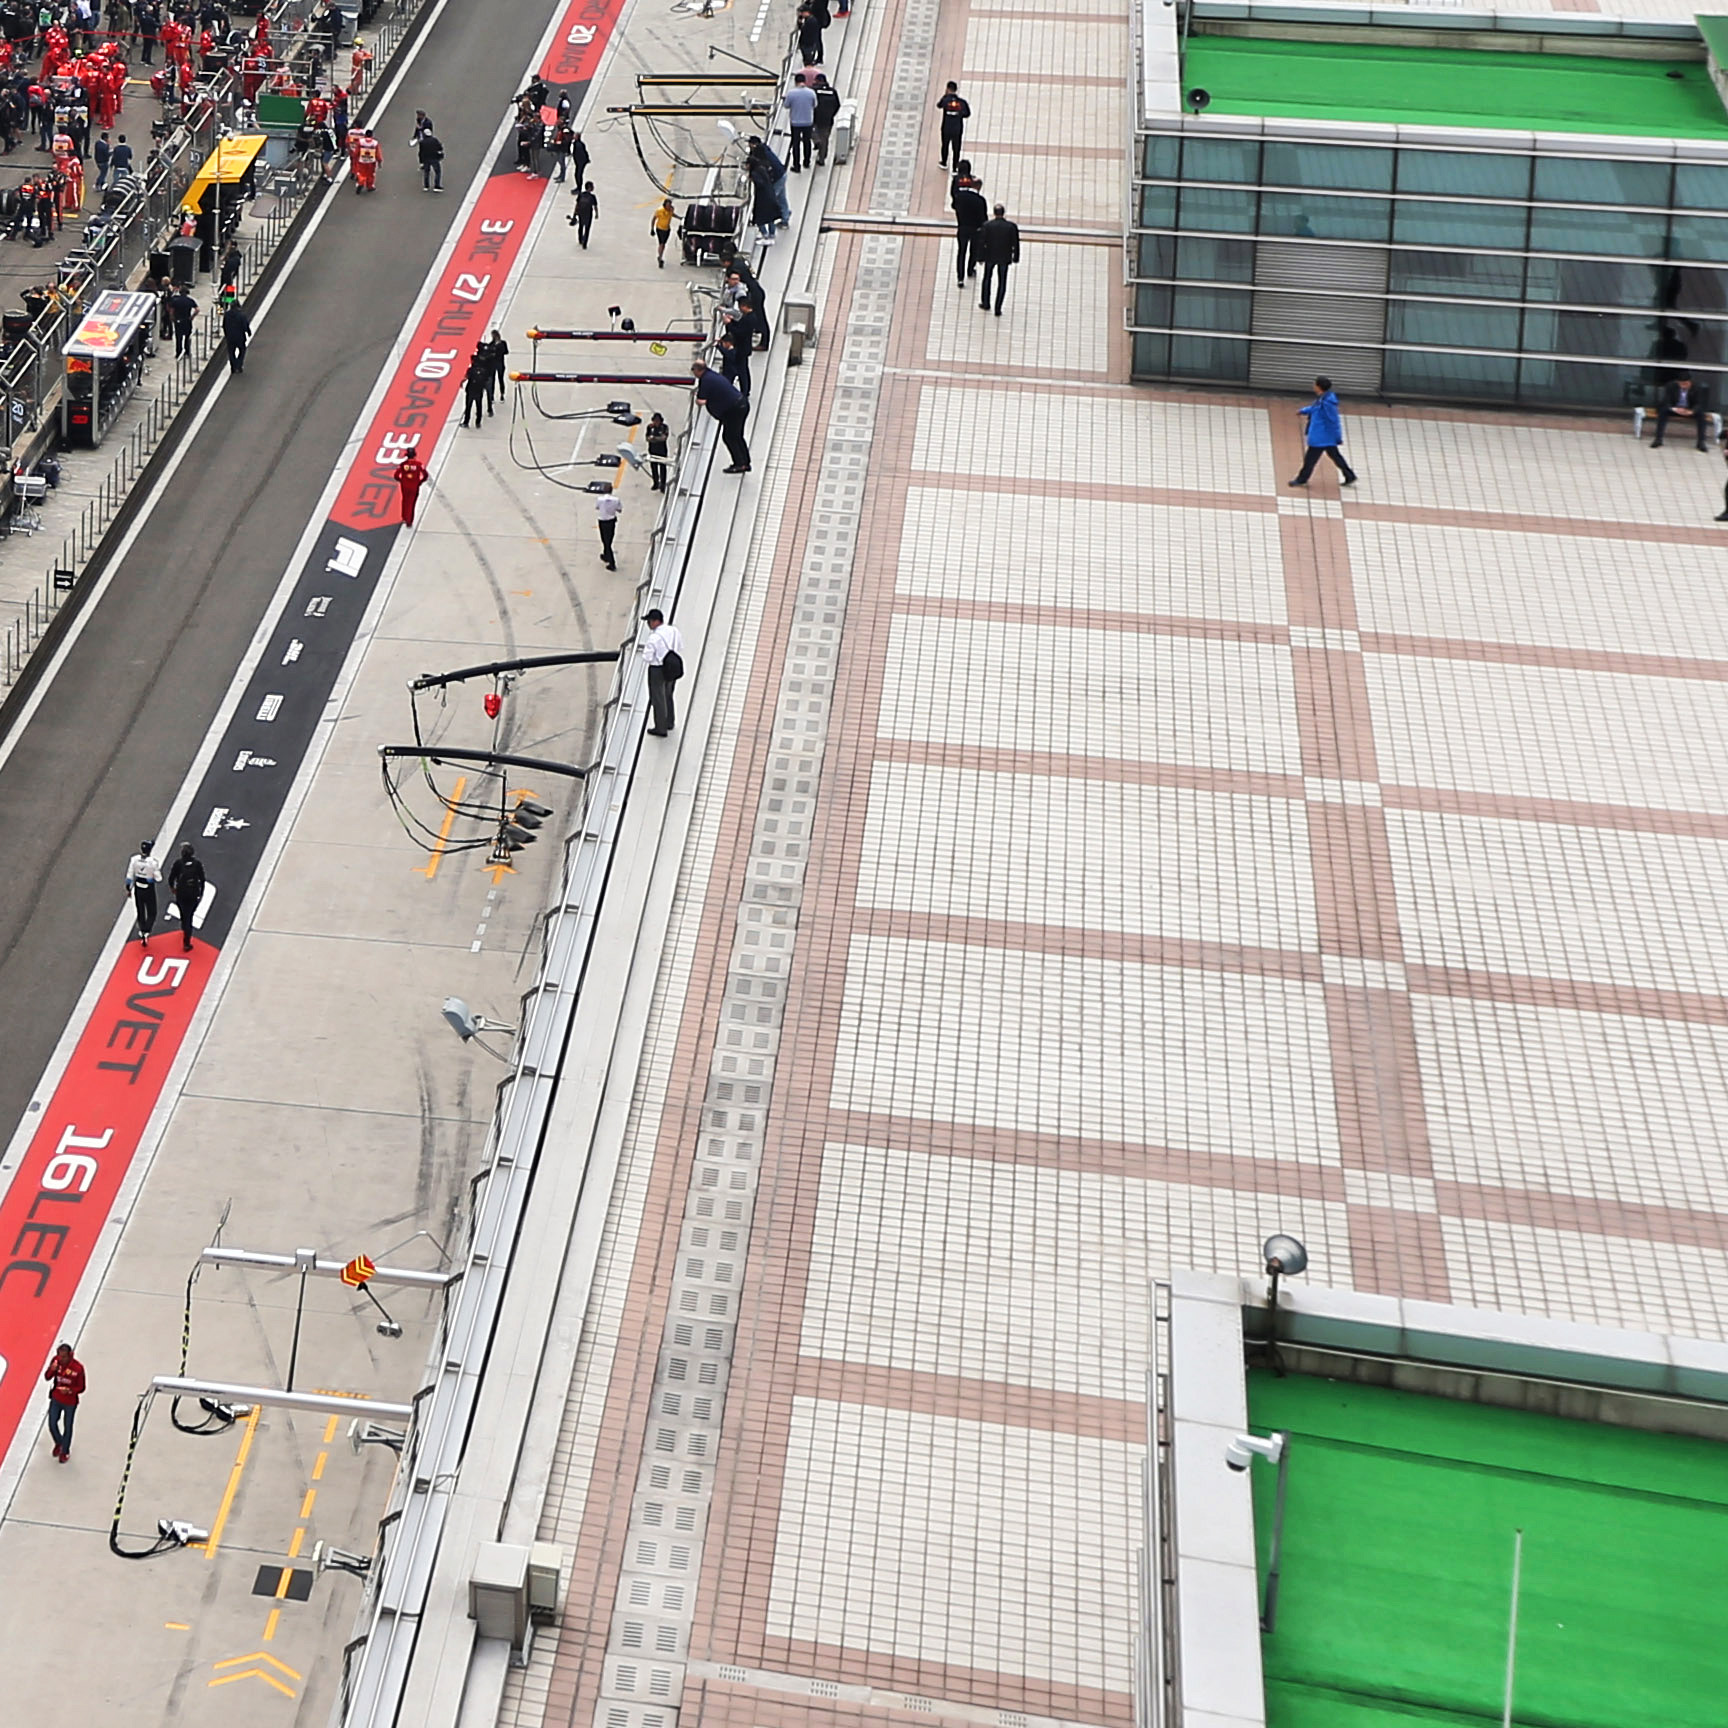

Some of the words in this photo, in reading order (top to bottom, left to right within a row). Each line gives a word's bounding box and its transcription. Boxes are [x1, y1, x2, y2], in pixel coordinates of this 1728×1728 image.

[567, 25, 597, 44] 20
[480, 219, 514, 234] 3
[451, 273, 491, 302] 27
[431, 298, 473, 343] HUL
[415, 347, 458, 379] 10
[392, 376, 443, 429] GAS
[376, 431, 421, 465] 33
[136, 955, 189, 989] 5
[97, 984, 167, 1084] VET
[40, 1124, 115, 1193] 16
